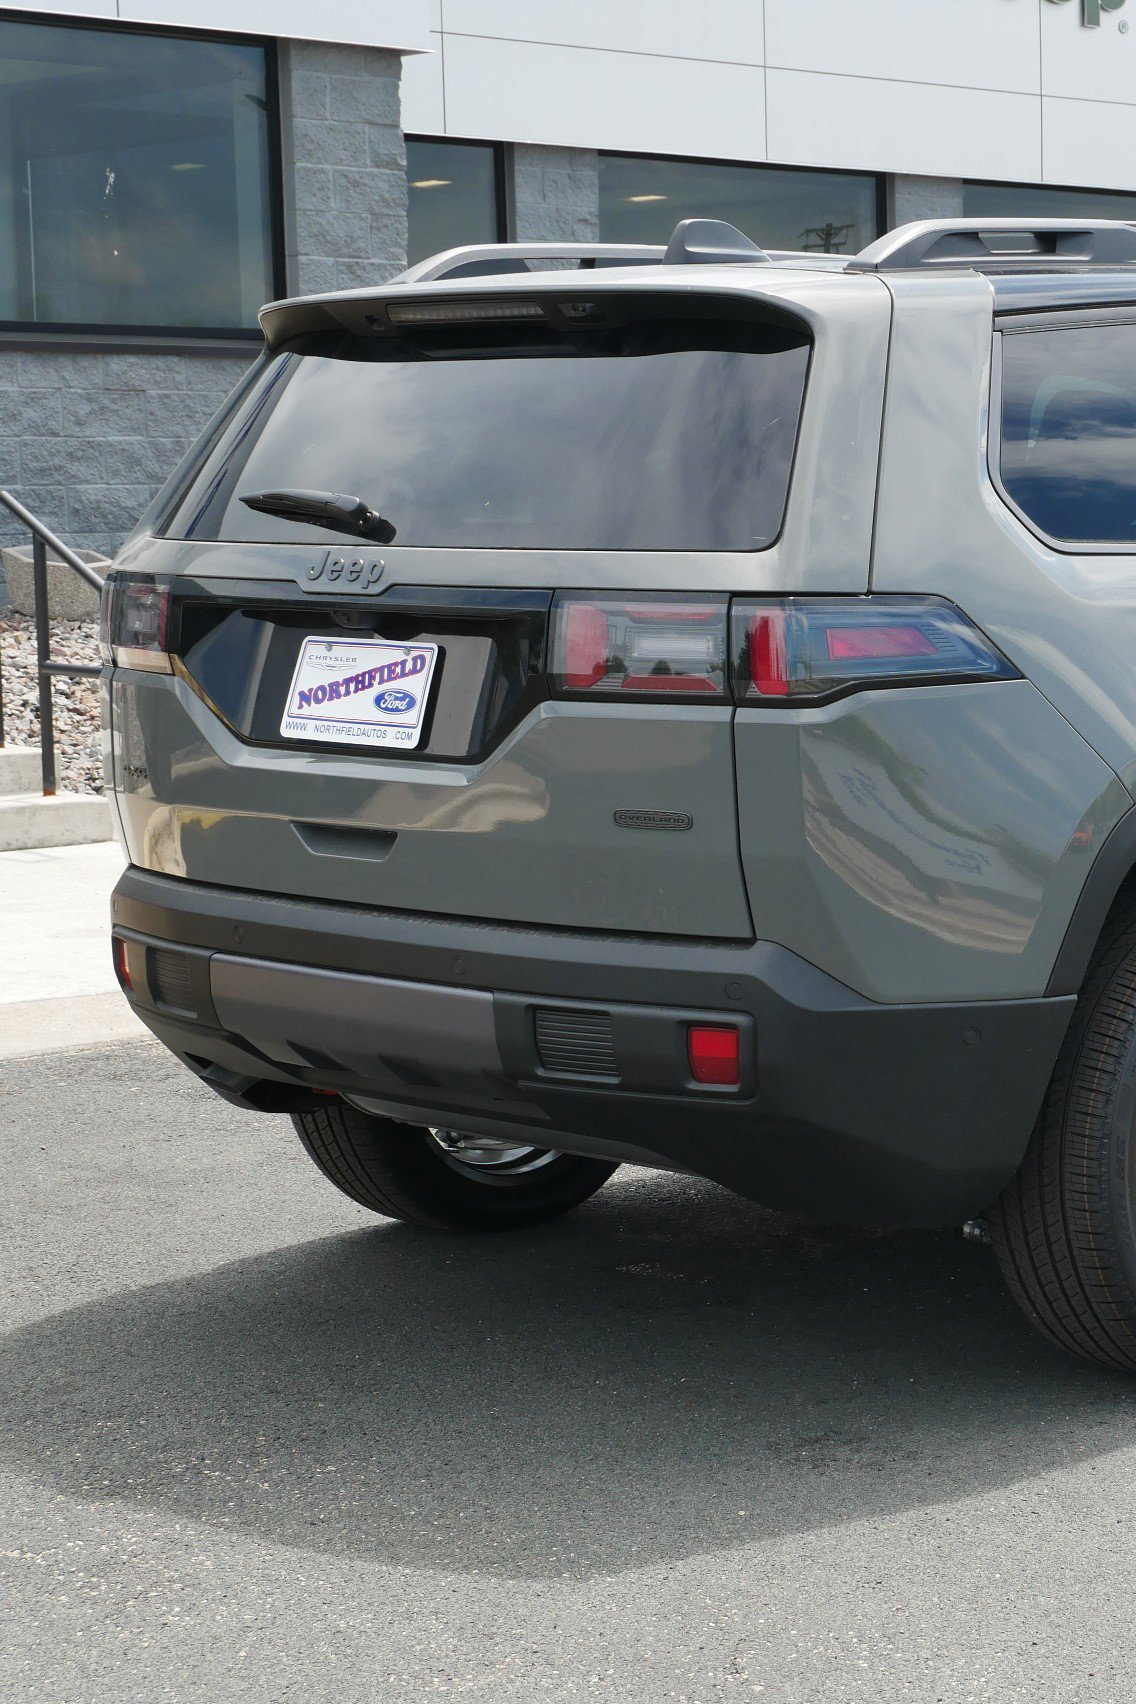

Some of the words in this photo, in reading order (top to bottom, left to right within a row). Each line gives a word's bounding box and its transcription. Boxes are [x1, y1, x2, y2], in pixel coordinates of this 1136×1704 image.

[306, 551, 385, 589] Jeep
[308, 654, 357, 663] CHRYSLER
[297, 654, 427, 710] NORTHFIELD
[380, 692, 408, 711] Ford
[285, 721, 308, 732] WWW.
[313, 724, 388, 739] NORTHFIELDAUTOS
[619, 814, 685, 824] OVERLAND
